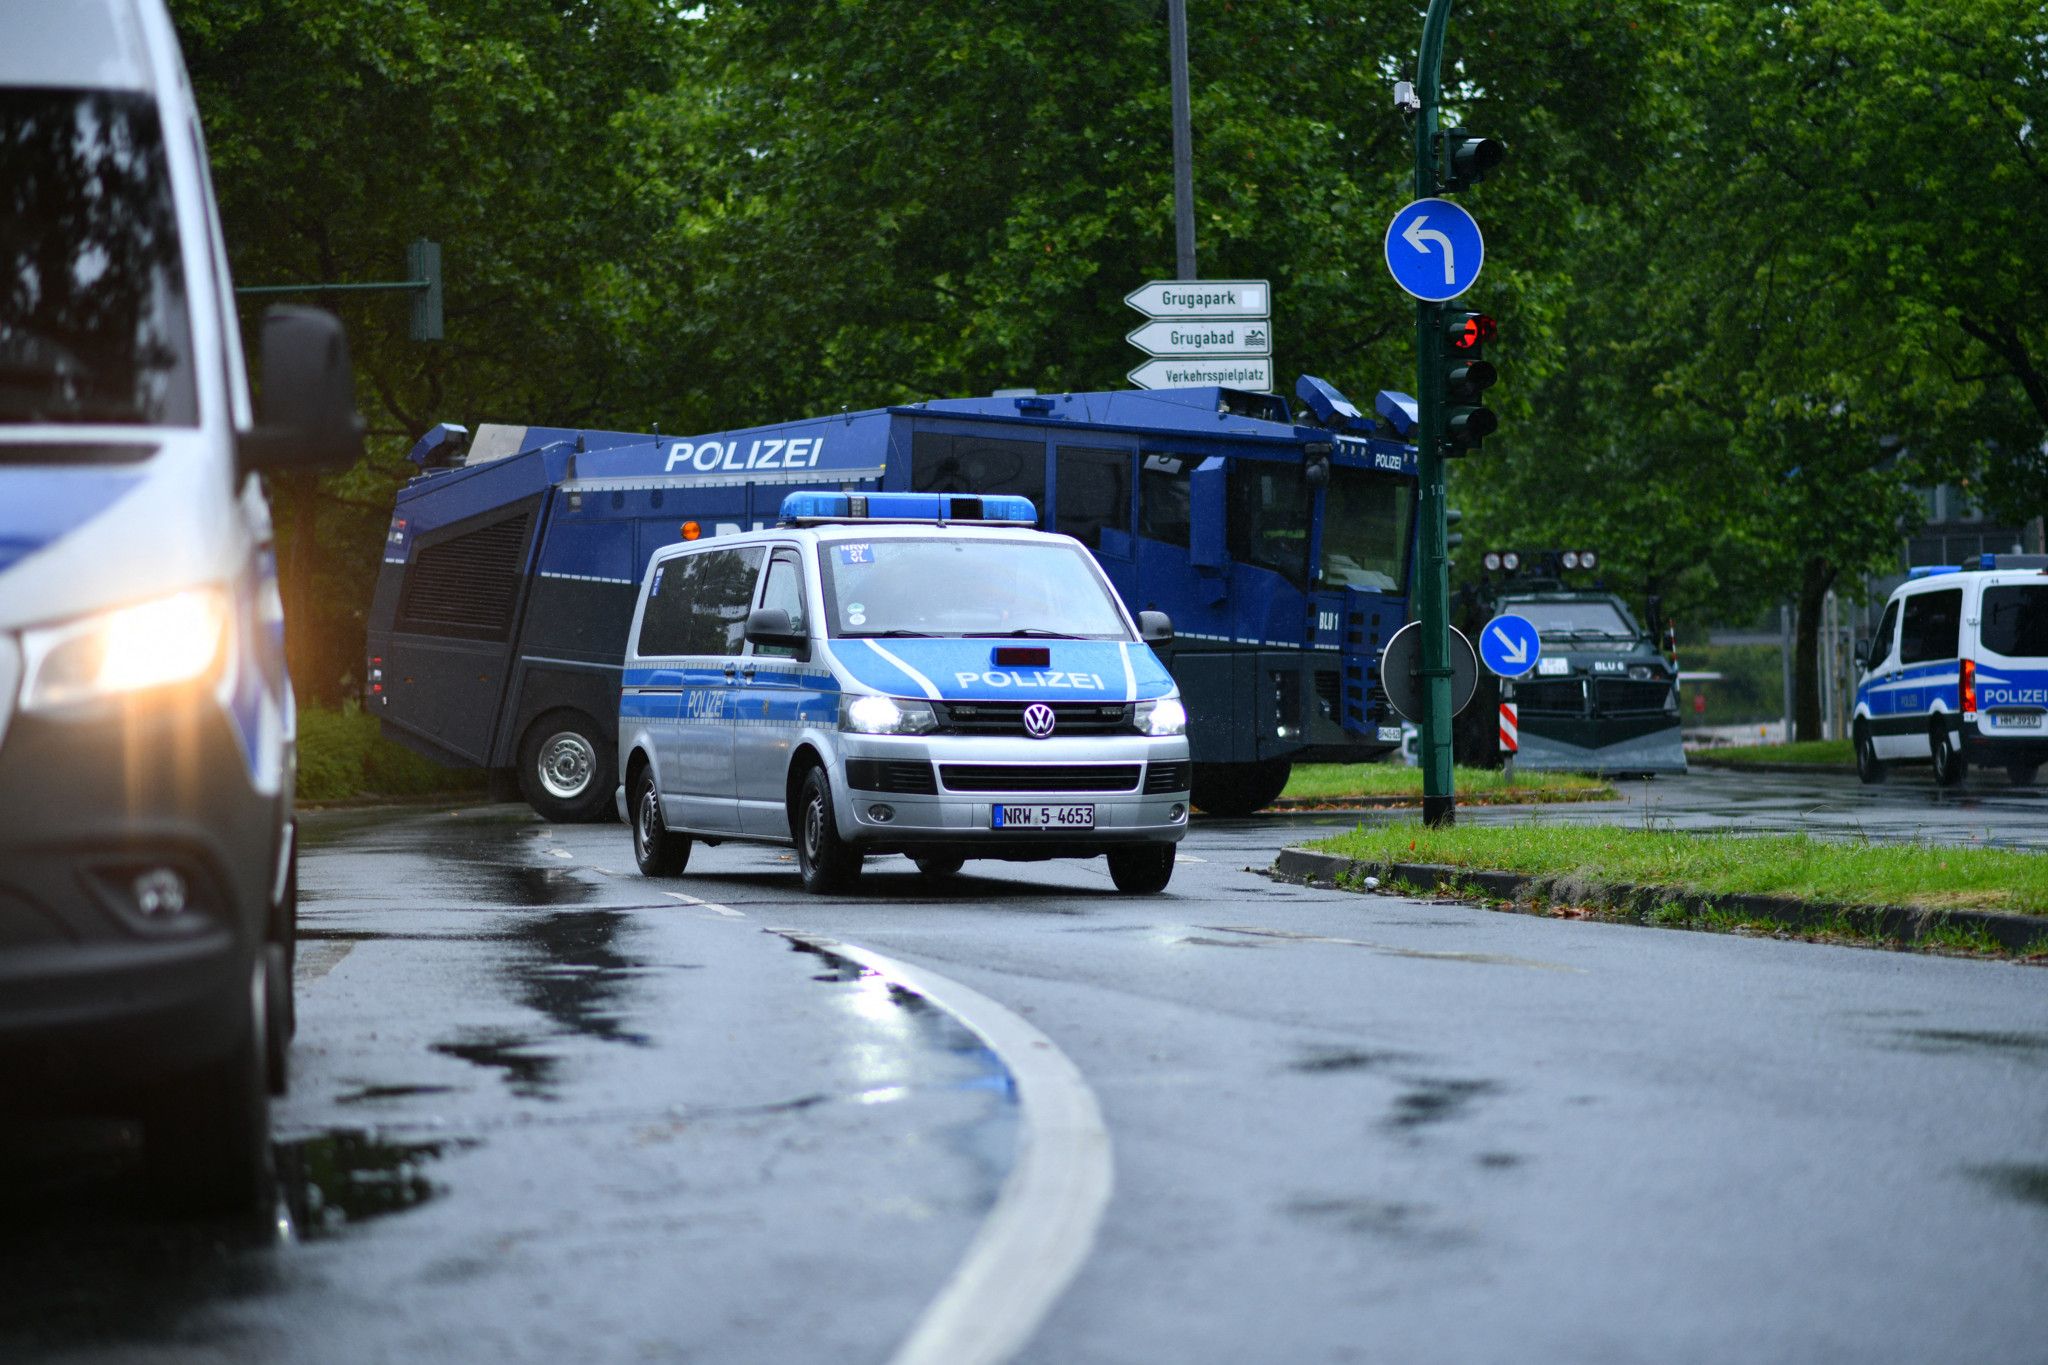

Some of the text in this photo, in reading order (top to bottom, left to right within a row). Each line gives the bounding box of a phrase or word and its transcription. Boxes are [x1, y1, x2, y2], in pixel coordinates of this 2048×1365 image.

[1162, 291, 1236, 309] Grugapark
[1171, 330, 1234, 348] Grugabad
[1166, 369, 1264, 384] Verkehrsspielplatz
[665, 438, 823, 472] POLIZEI
[1375, 453, 1402, 470] POLIZEI
[1319, 612, 1339, 631] BLU 1
[1594, 661, 1616, 671] BLU
[954, 671, 1105, 690] POLIZEI
[687, 690, 727, 718] POLIZEI
[1984, 690, 2048, 703] POLIZEI
[1004, 808, 1093, 824] NRW 5-4653
